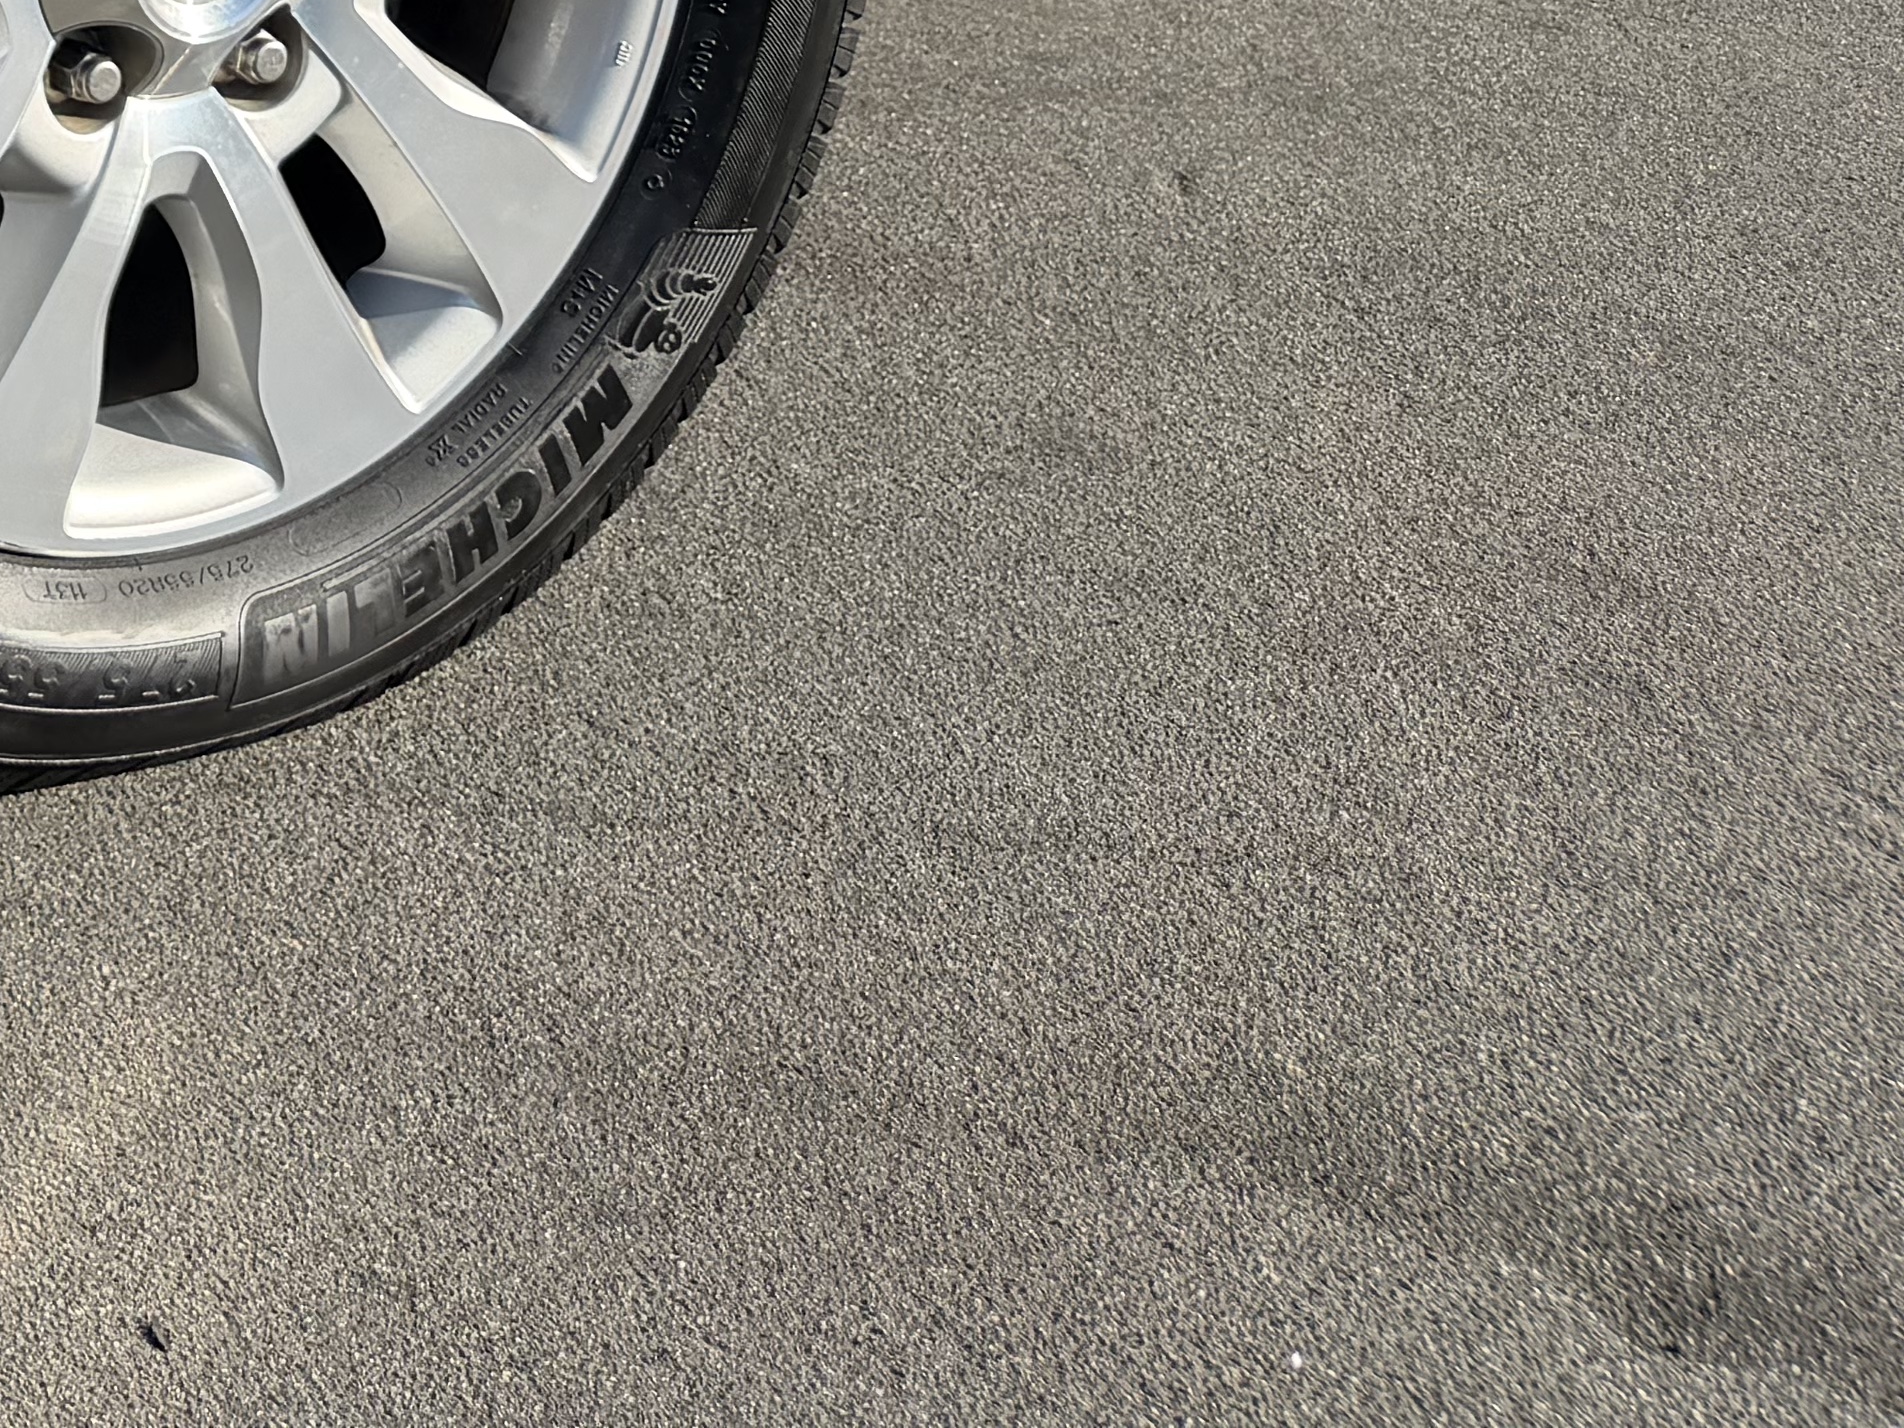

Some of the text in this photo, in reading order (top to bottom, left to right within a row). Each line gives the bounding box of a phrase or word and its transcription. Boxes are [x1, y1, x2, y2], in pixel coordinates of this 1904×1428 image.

[555, 284, 620, 368] MICHELIN
[450, 381, 508, 436] RADIAL
[455, 395, 535, 469] TUBELESS
[261, 362, 634, 690] MICHELIN
[43, 554, 255, 602] 275/55R20 113T
